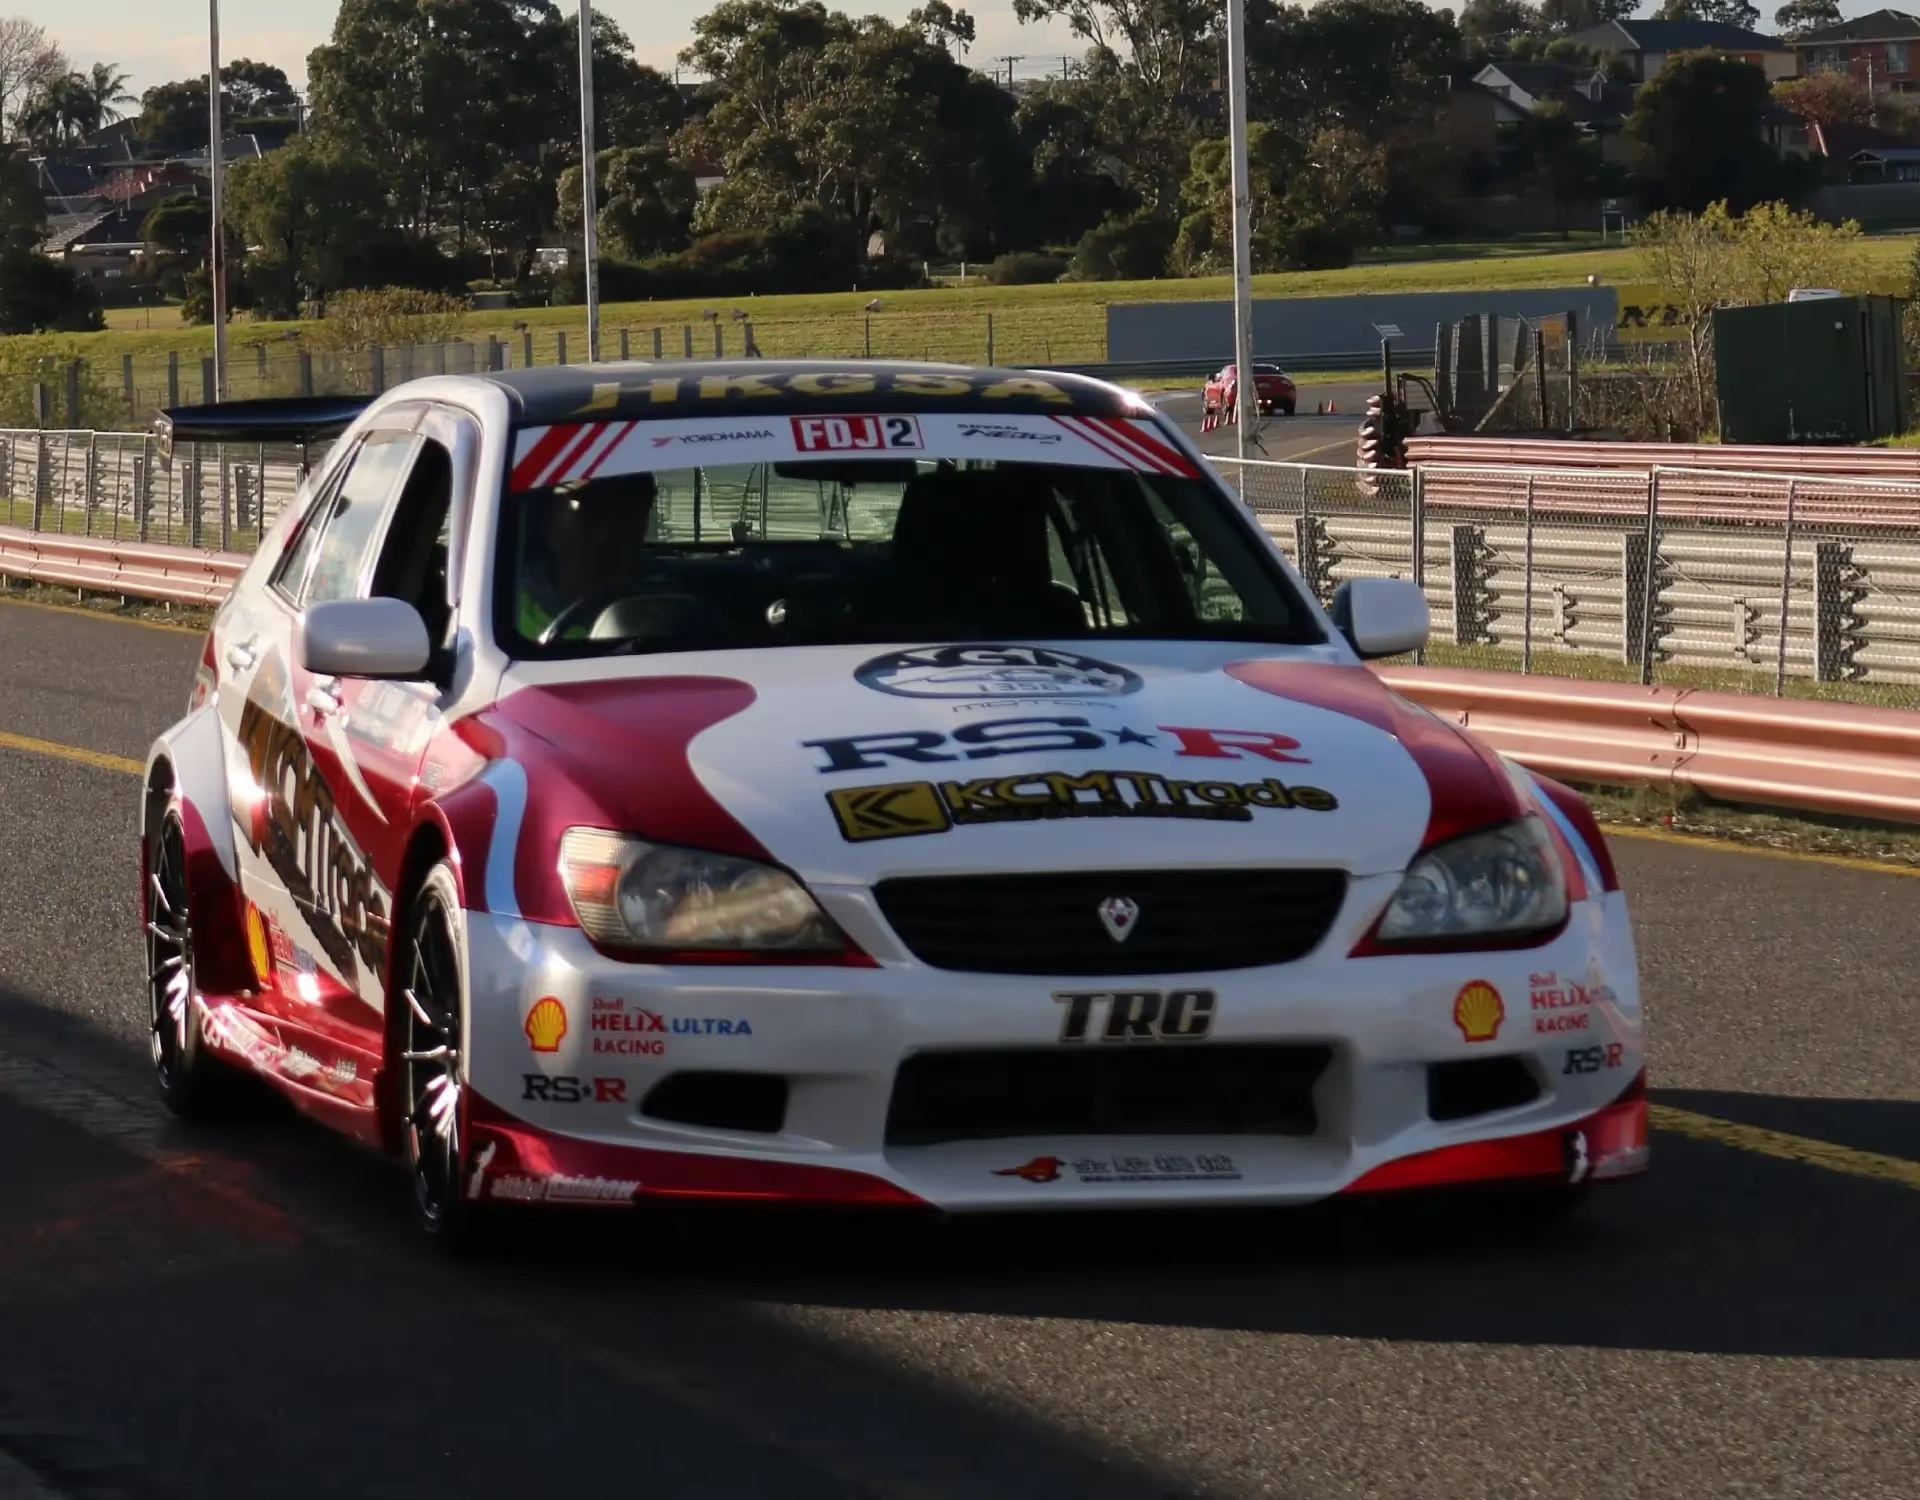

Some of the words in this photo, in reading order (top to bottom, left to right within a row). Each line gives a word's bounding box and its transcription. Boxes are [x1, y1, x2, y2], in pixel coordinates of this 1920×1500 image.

[679, 429, 775, 444] YOKOHAMA
[591, 1008, 668, 1033] HELIX
[672, 1018, 752, 1036] ULTRA
[1535, 1013, 1589, 1033] RACING
[593, 1038, 665, 1055] RACING
